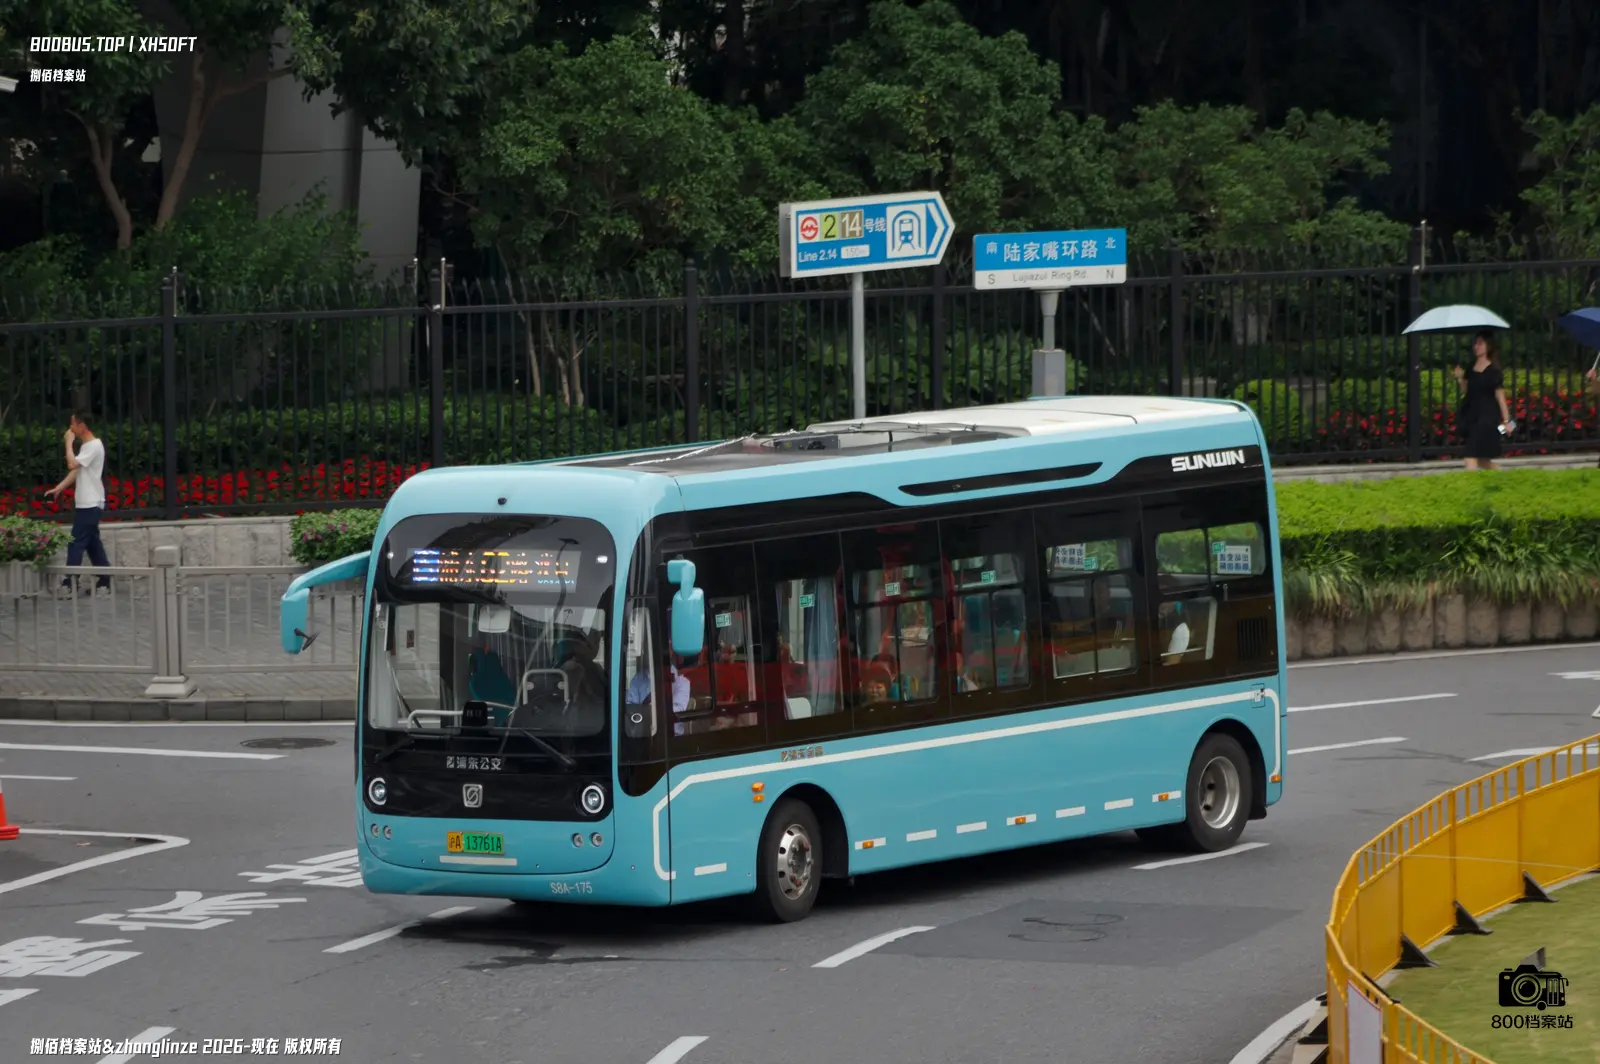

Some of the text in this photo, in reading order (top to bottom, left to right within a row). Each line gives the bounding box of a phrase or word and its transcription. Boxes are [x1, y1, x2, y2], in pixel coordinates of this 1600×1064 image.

[823, 212, 887, 239] 2 14 号线
[798, 252, 818, 263] Line
[986, 236, 1117, 263] 南 陆家嘴环路 北
[987, 273, 996, 285] S
[1012, 271, 1048, 283] Lujiazui
[1051, 270, 1072, 281] Ring
[1106, 269, 1115, 279] N
[1171, 449, 1245, 472] SUNWIN
[550, 881, 593, 895] S8A-175
